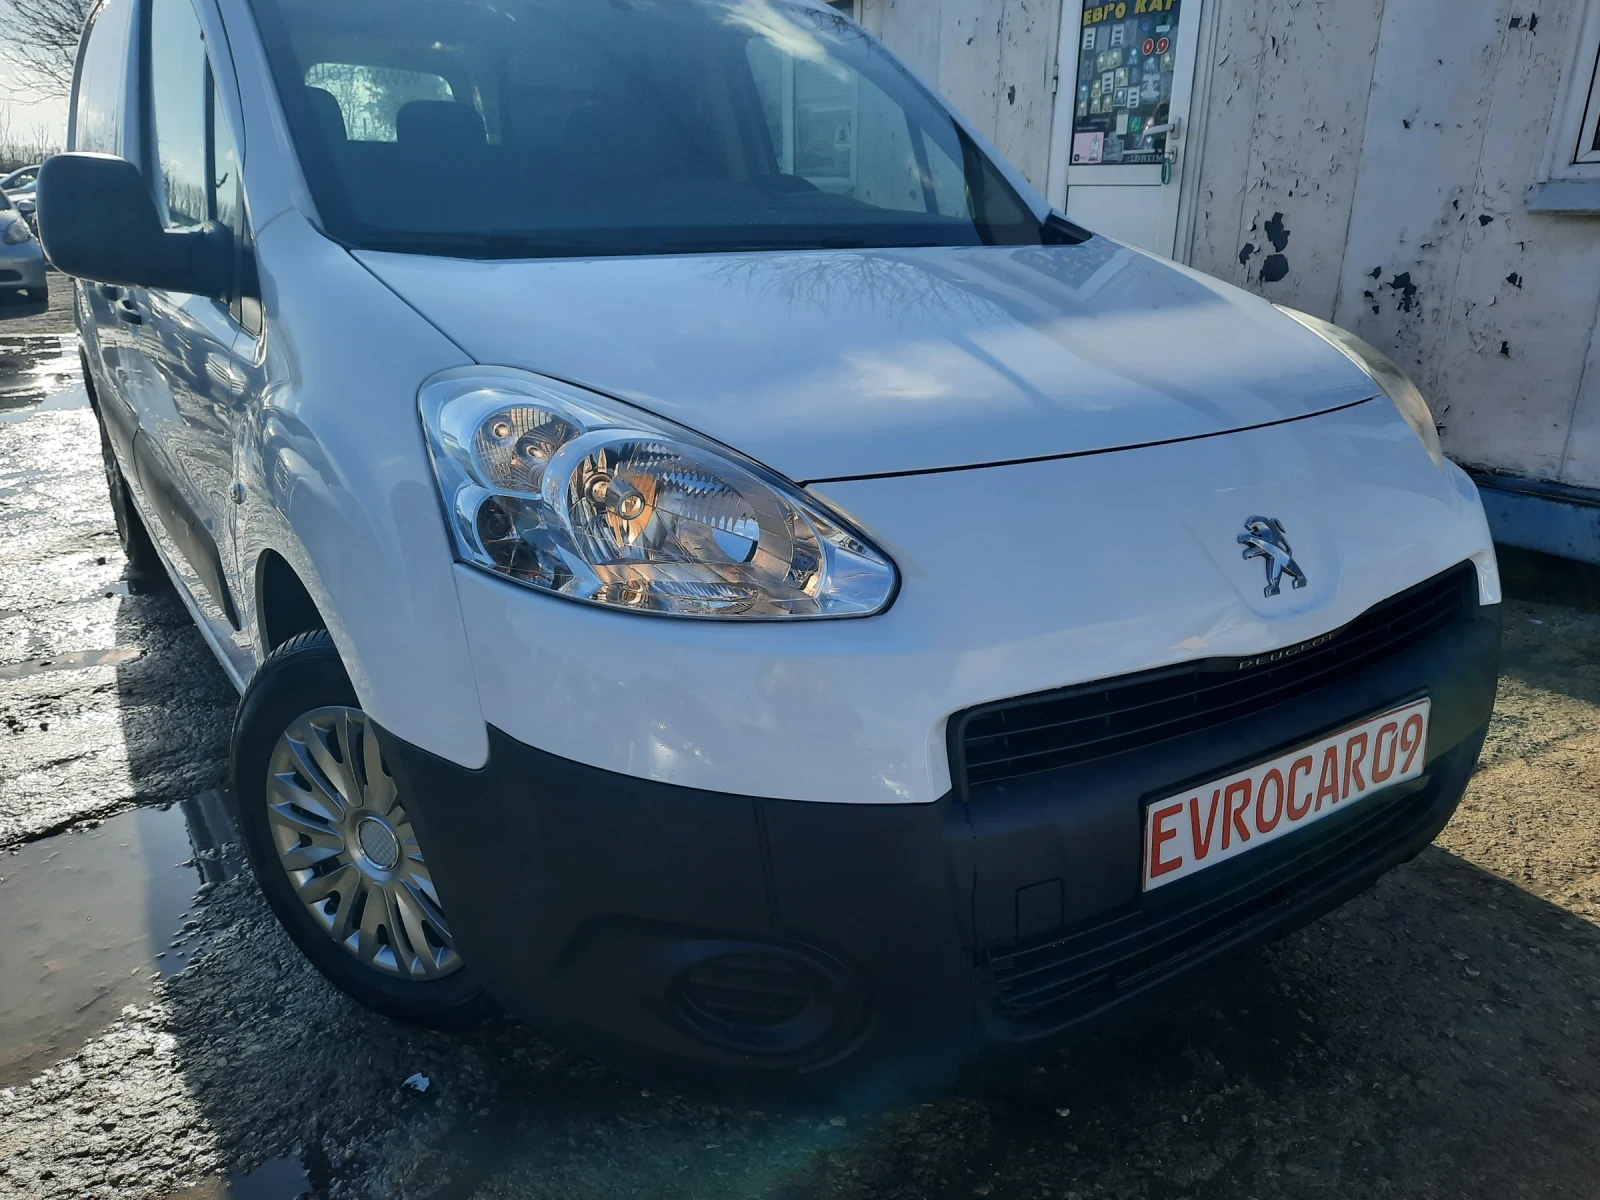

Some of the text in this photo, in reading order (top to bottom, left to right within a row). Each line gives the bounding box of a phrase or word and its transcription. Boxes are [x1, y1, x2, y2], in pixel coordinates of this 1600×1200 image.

[1082, 2, 1126, 26] ЕВРО
[1142, 37, 1169, 55] 09
[1239, 633, 1333, 670] PEUGEOT
[1150, 713, 1424, 879] EVROCAR09
